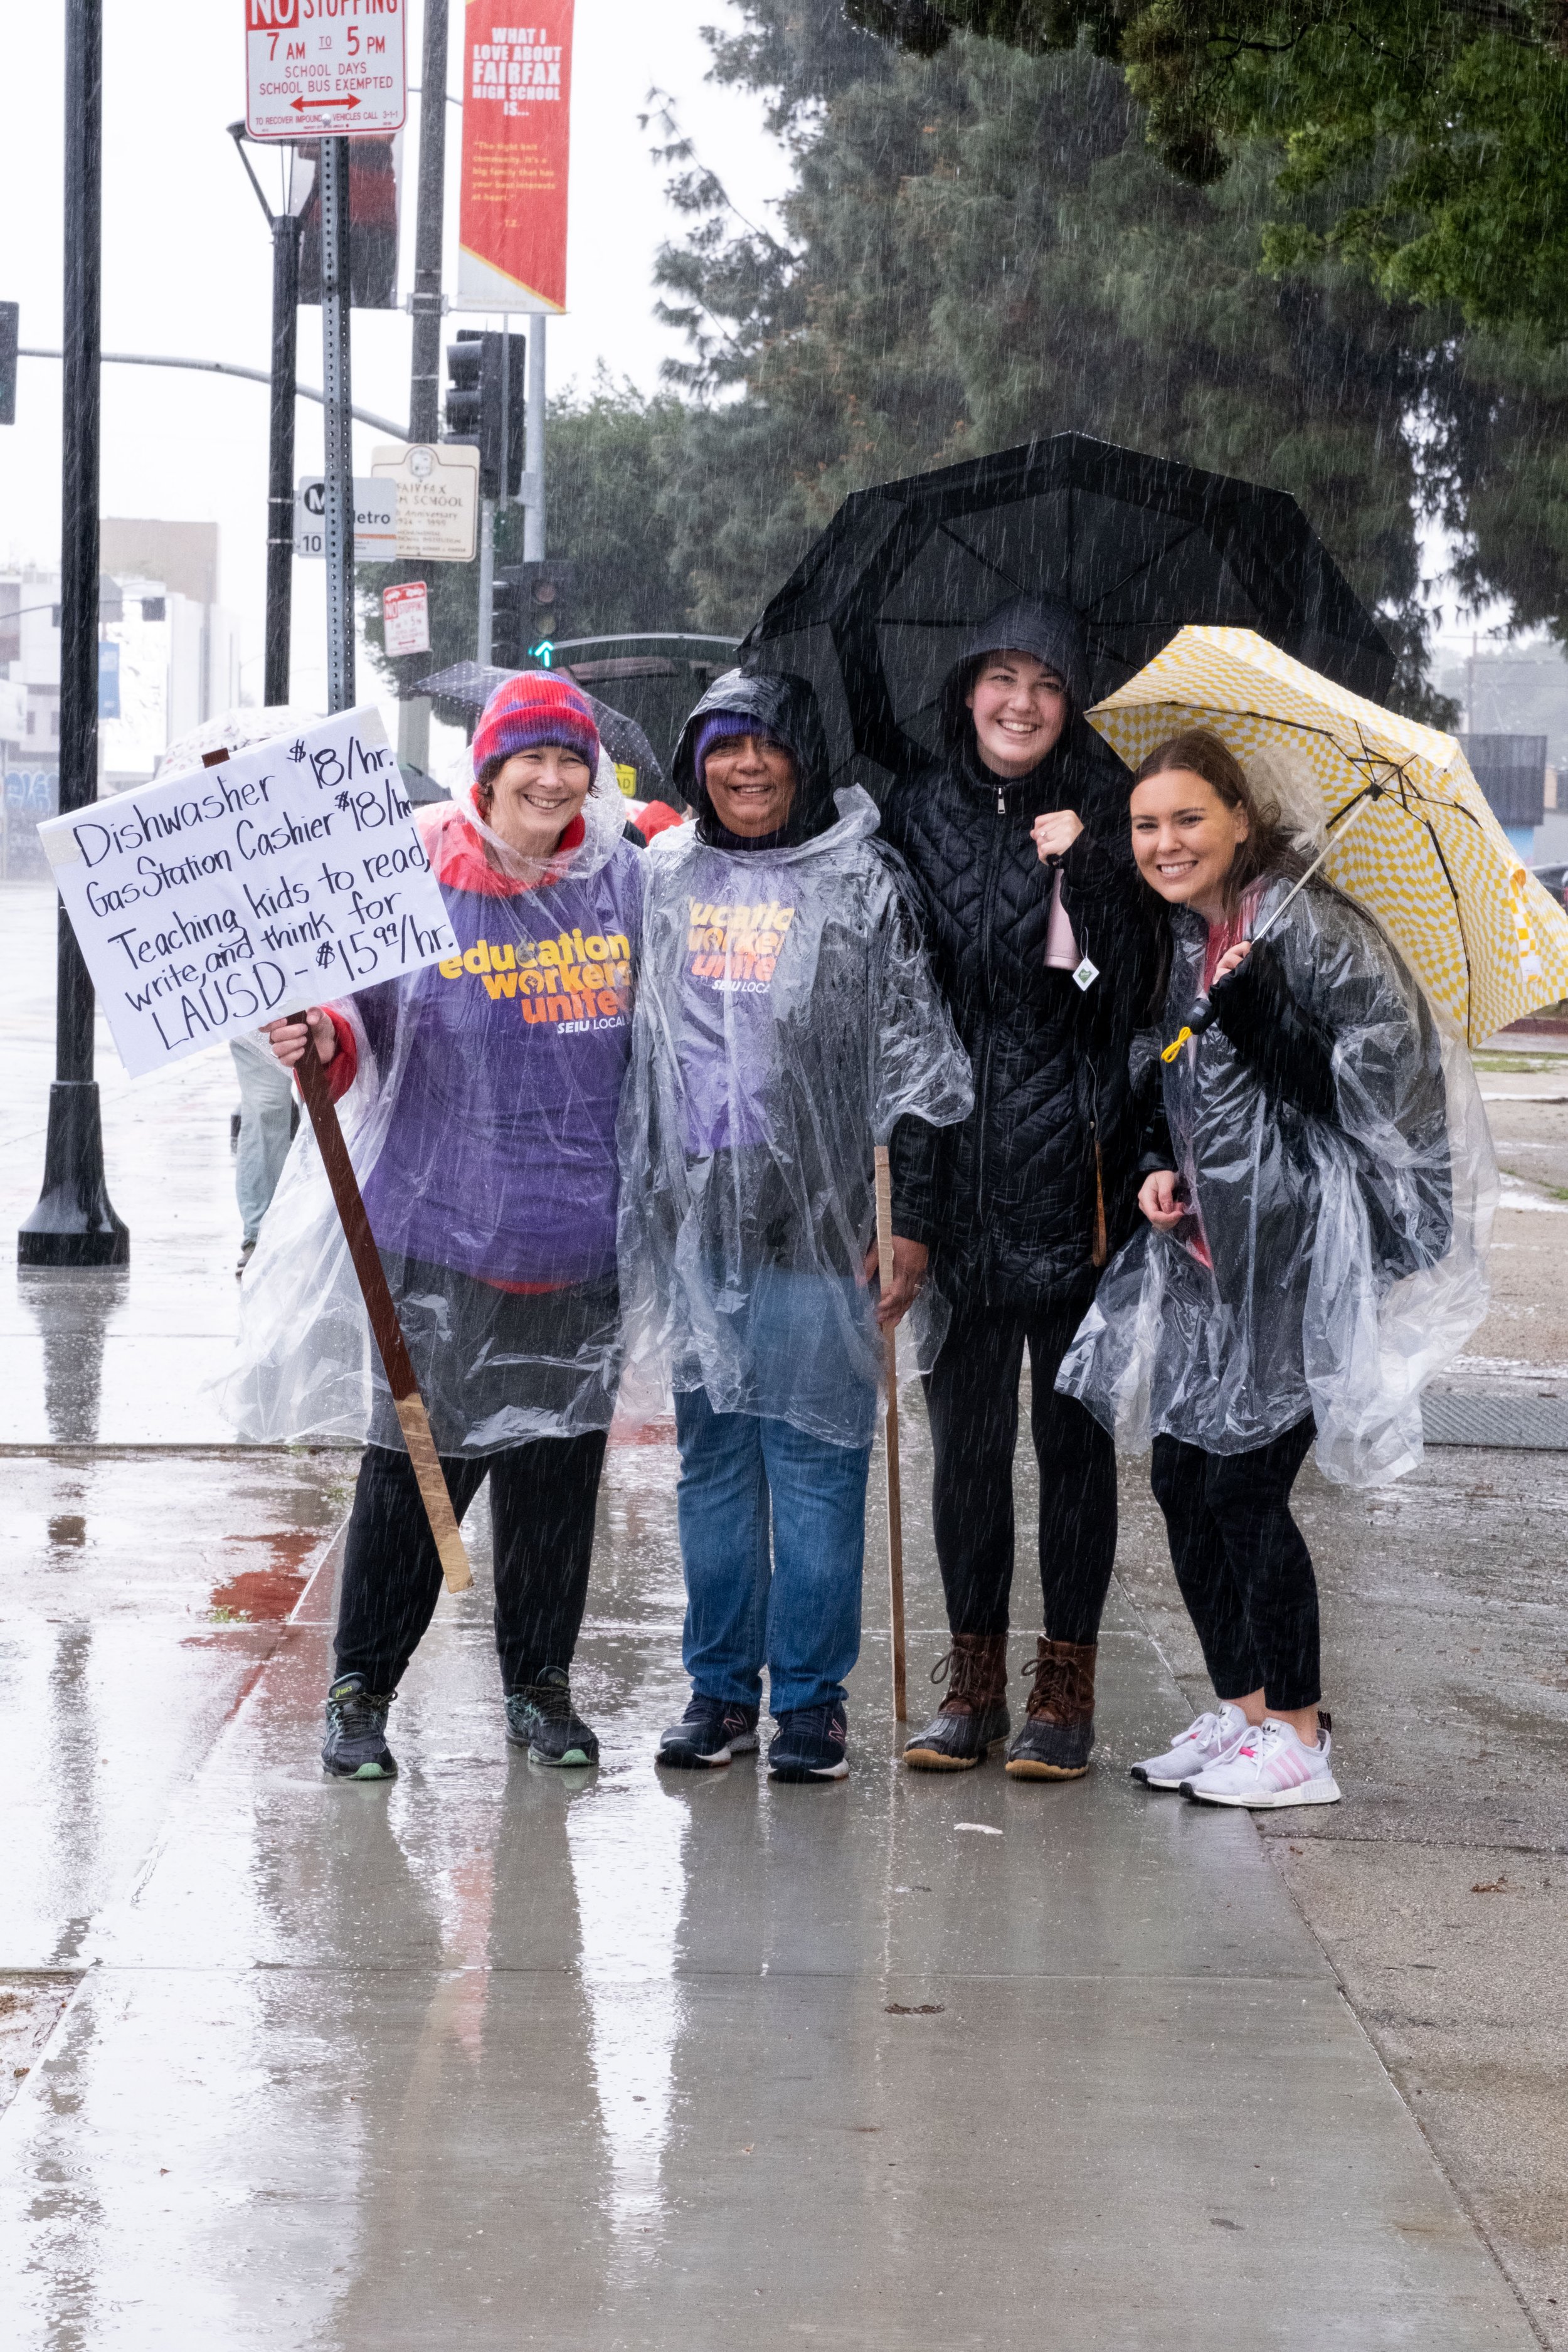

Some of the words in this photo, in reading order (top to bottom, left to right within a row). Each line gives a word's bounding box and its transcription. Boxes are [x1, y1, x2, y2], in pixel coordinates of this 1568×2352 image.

[267, 32, 280, 61] 7
[287, 42, 305, 60] AM
[319, 36, 332, 47] TO
[347, 26, 360, 56] 5
[367, 36, 385, 54] PM
[492, 28, 536, 44] WHAT
[540, 29, 546, 44] I
[474, 45, 509, 60] LOVE
[513, 46, 562, 61] ABOUT
[285, 64, 331, 78] SCHOOL
[338, 62, 366, 75] DAYS
[473, 60, 561, 85] FAIRFAX
[260, 82, 302, 95] SCHOOL
[308, 79, 330, 92] BUS
[336, 76, 393, 91] EXEMPTED
[473, 85, 506, 99] HIGH
[509, 86, 561, 100] SCHOOL
[265, 115, 293, 124] RECOVER
[295, 114, 322, 123] IMPOUND
[333, 113, 361, 122] VEHICLES
[363, 112, 378, 120] CALL
[383, 110, 398, 119] 3-1-1
[503, 101, 529, 116] IS...
[414, 495, 463, 507] SCHOOL
[354, 511, 390, 524] etro
[303, 535, 322, 552] 10
[73, 776, 275, 868] Dishwasher
[236, 812, 335, 860] Cashier
[107, 909, 246, 970] Teaching
[243, 876, 309, 919] kids
[317, 862, 354, 894] to
[363, 827, 430, 882] read,
[260, 911, 334, 951] think
[347, 891, 402, 924] for
[439, 928, 630, 979] education
[152, 961, 286, 1050] LAUSD
[557, 1020, 590, 1034] SEIU
